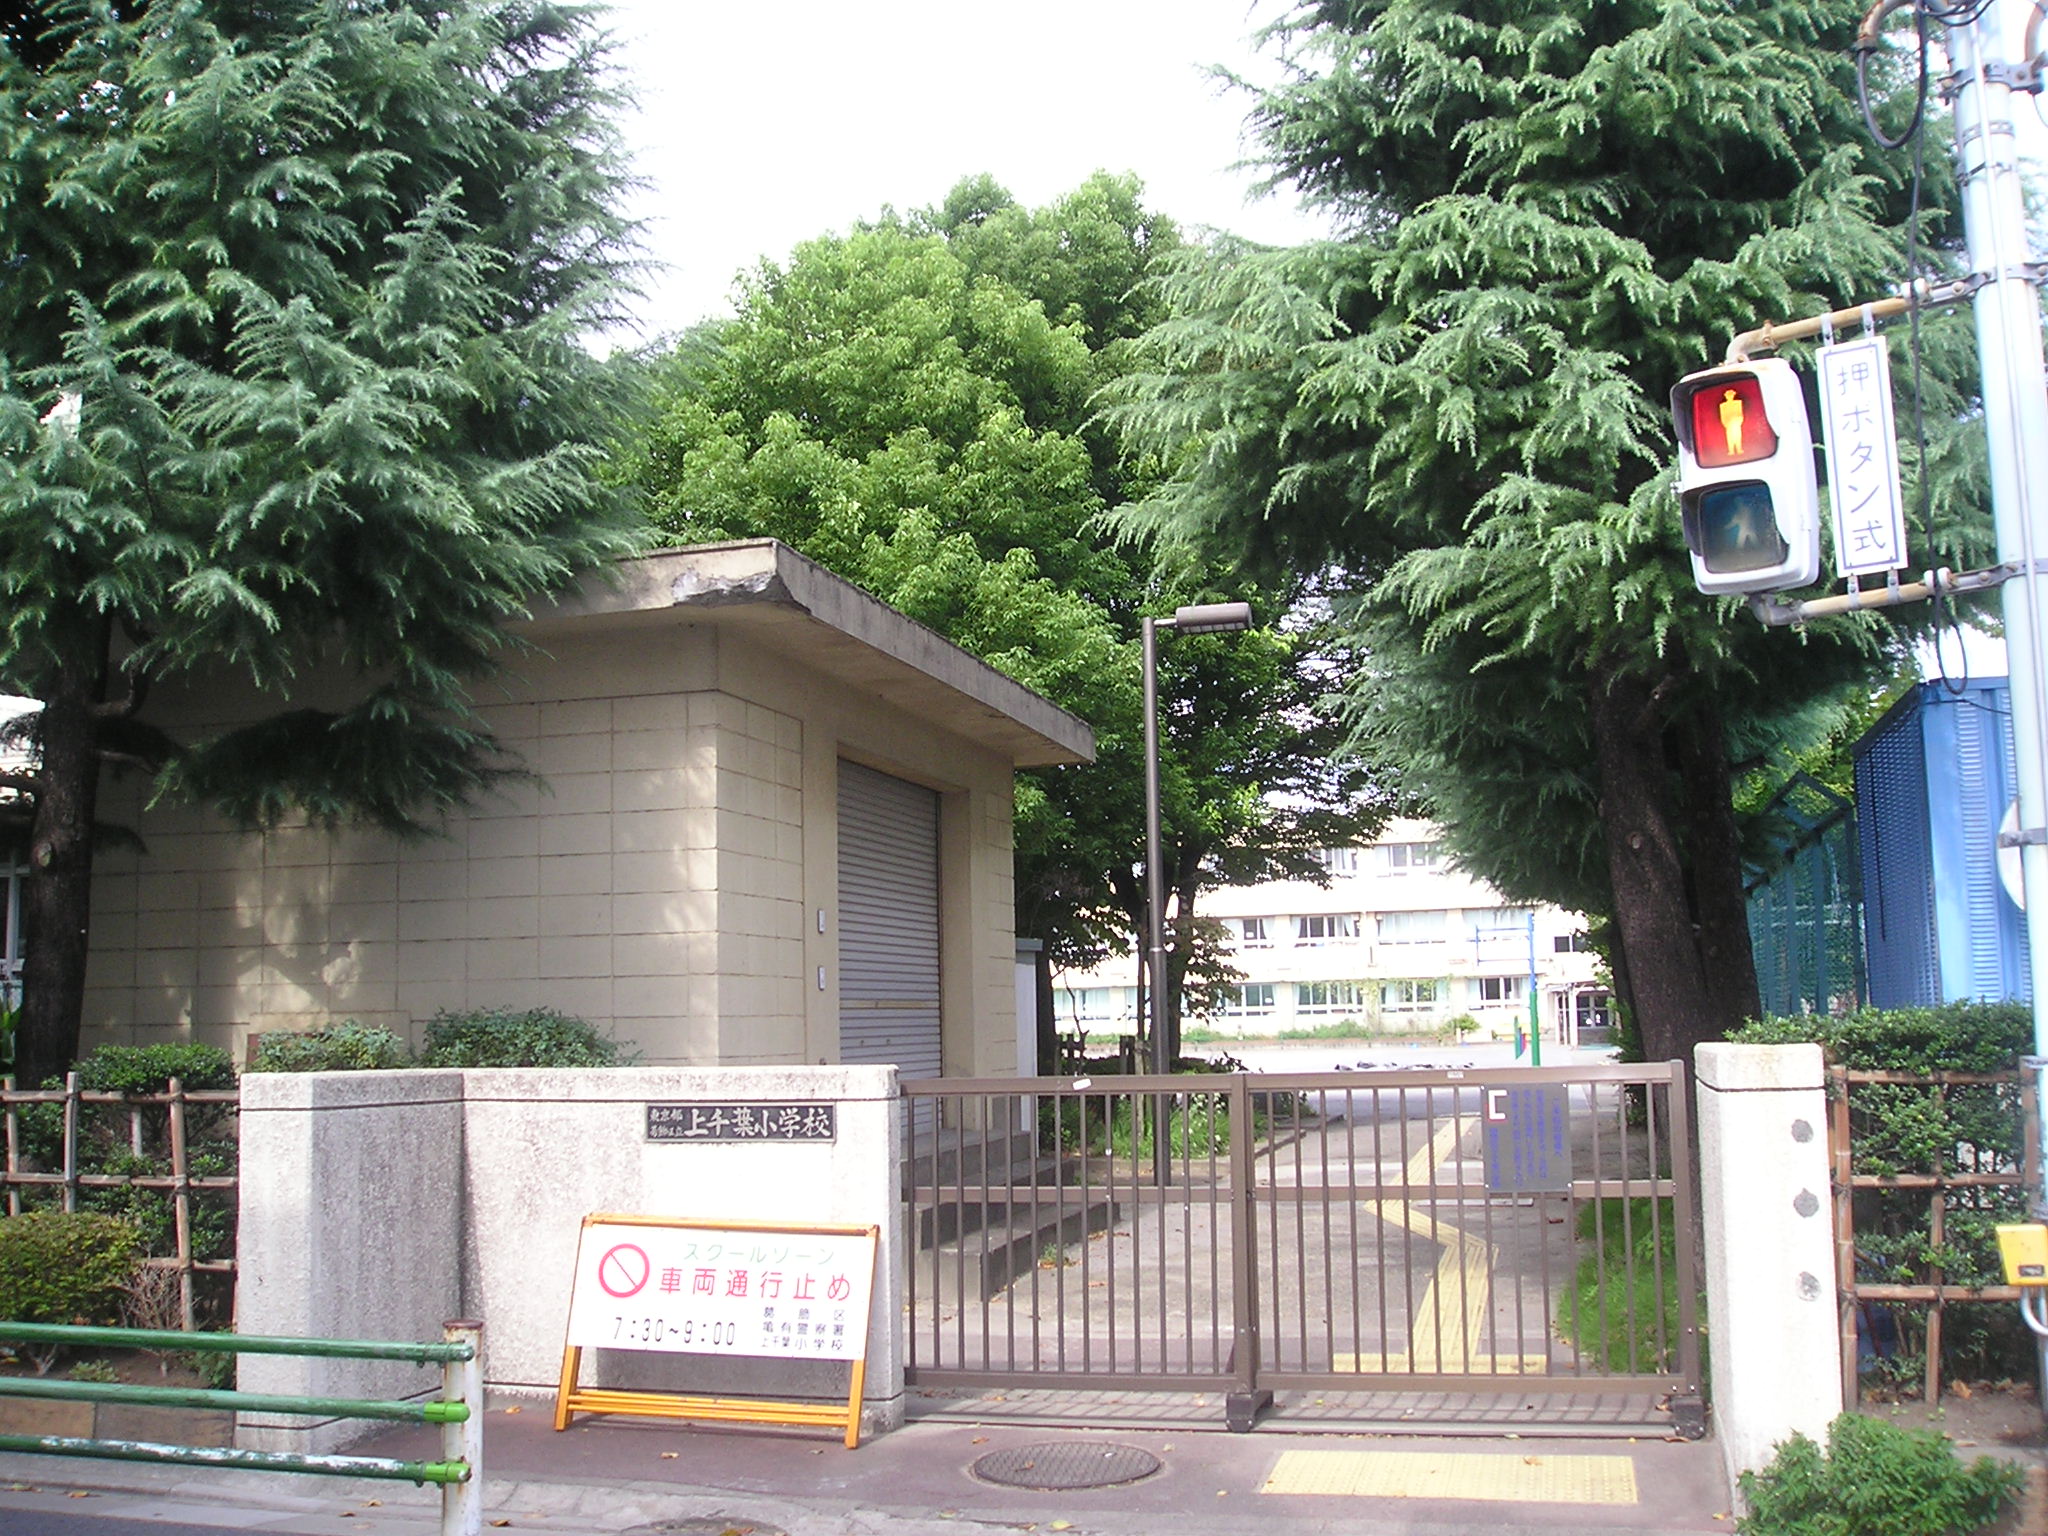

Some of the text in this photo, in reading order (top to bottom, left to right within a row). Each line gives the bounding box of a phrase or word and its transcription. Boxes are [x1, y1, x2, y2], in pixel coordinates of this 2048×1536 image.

[1837, 361, 1886, 552] 押ボタン式
[684, 1107, 832, 1138] 上千葉小学校
[659, 1267, 851, 1301] 車両通行止め
